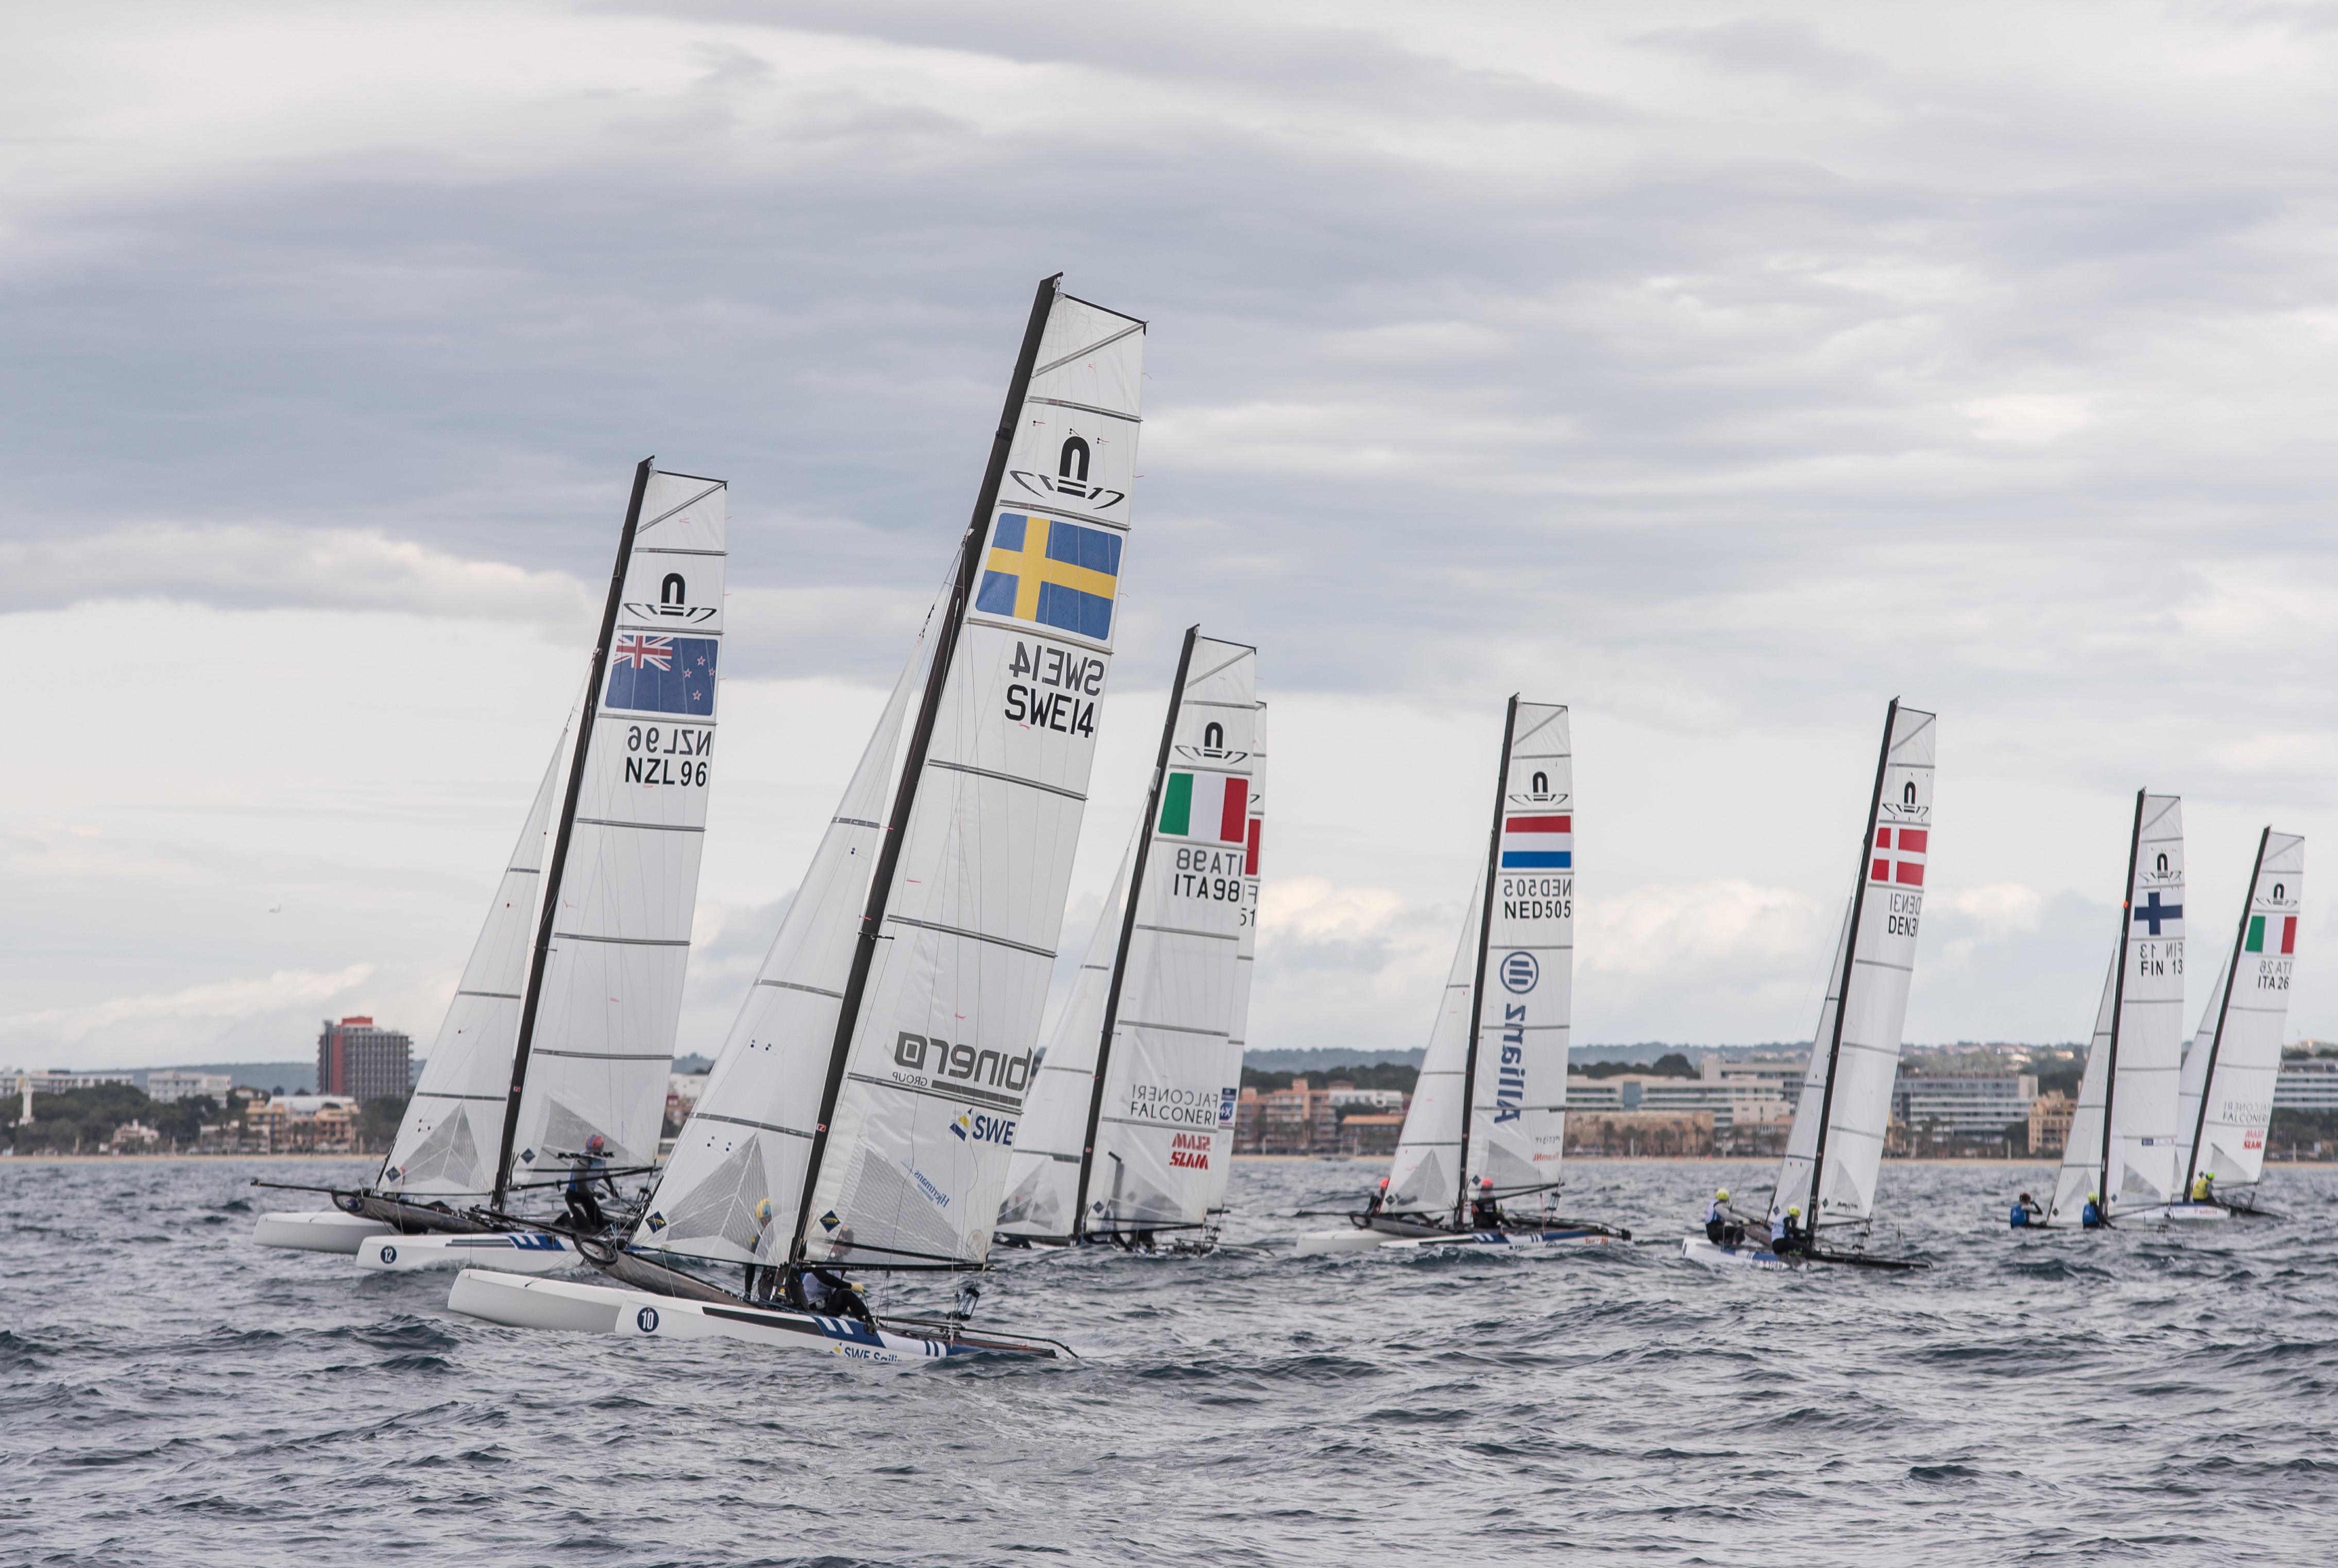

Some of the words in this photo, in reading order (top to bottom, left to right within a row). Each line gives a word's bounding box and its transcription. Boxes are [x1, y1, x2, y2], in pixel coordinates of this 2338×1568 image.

[1005, 684, 1094, 738] SWE14
[1174, 874, 1239, 902] ITA98
[1505, 901, 1571, 919] NED505
[2141, 961, 2163, 976] FIN
[2173, 959, 2183, 975] 13
[1131, 1101, 1216, 1126] FALCONERI
[972, 1115, 1015, 1146] SWE
[1169, 1151, 1208, 1169] SLAM
[384, 1249, 393, 1262] 12
[642, 1311, 654, 1330] 10
